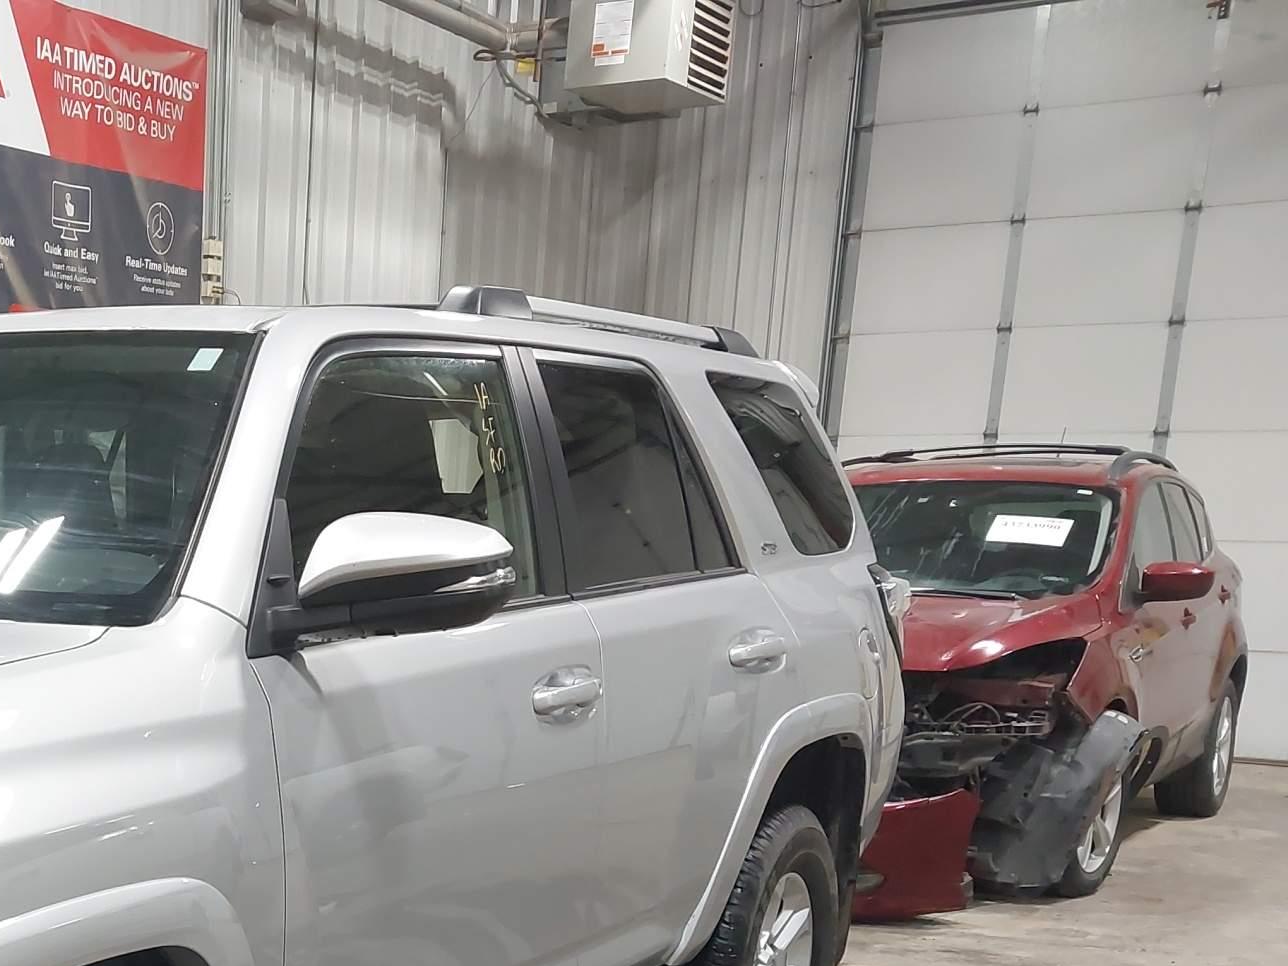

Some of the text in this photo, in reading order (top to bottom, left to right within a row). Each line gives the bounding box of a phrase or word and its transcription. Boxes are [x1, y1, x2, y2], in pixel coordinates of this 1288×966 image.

[63, 47, 116, 80] TIMED
[53, 70, 184, 121] INTRODUCING A NEW
[60, 97, 176, 141] WAY TO BID & BUY
[44, 241, 99, 264] Quick and Easy
[125, 255, 188, 277] Real-Time Updates
